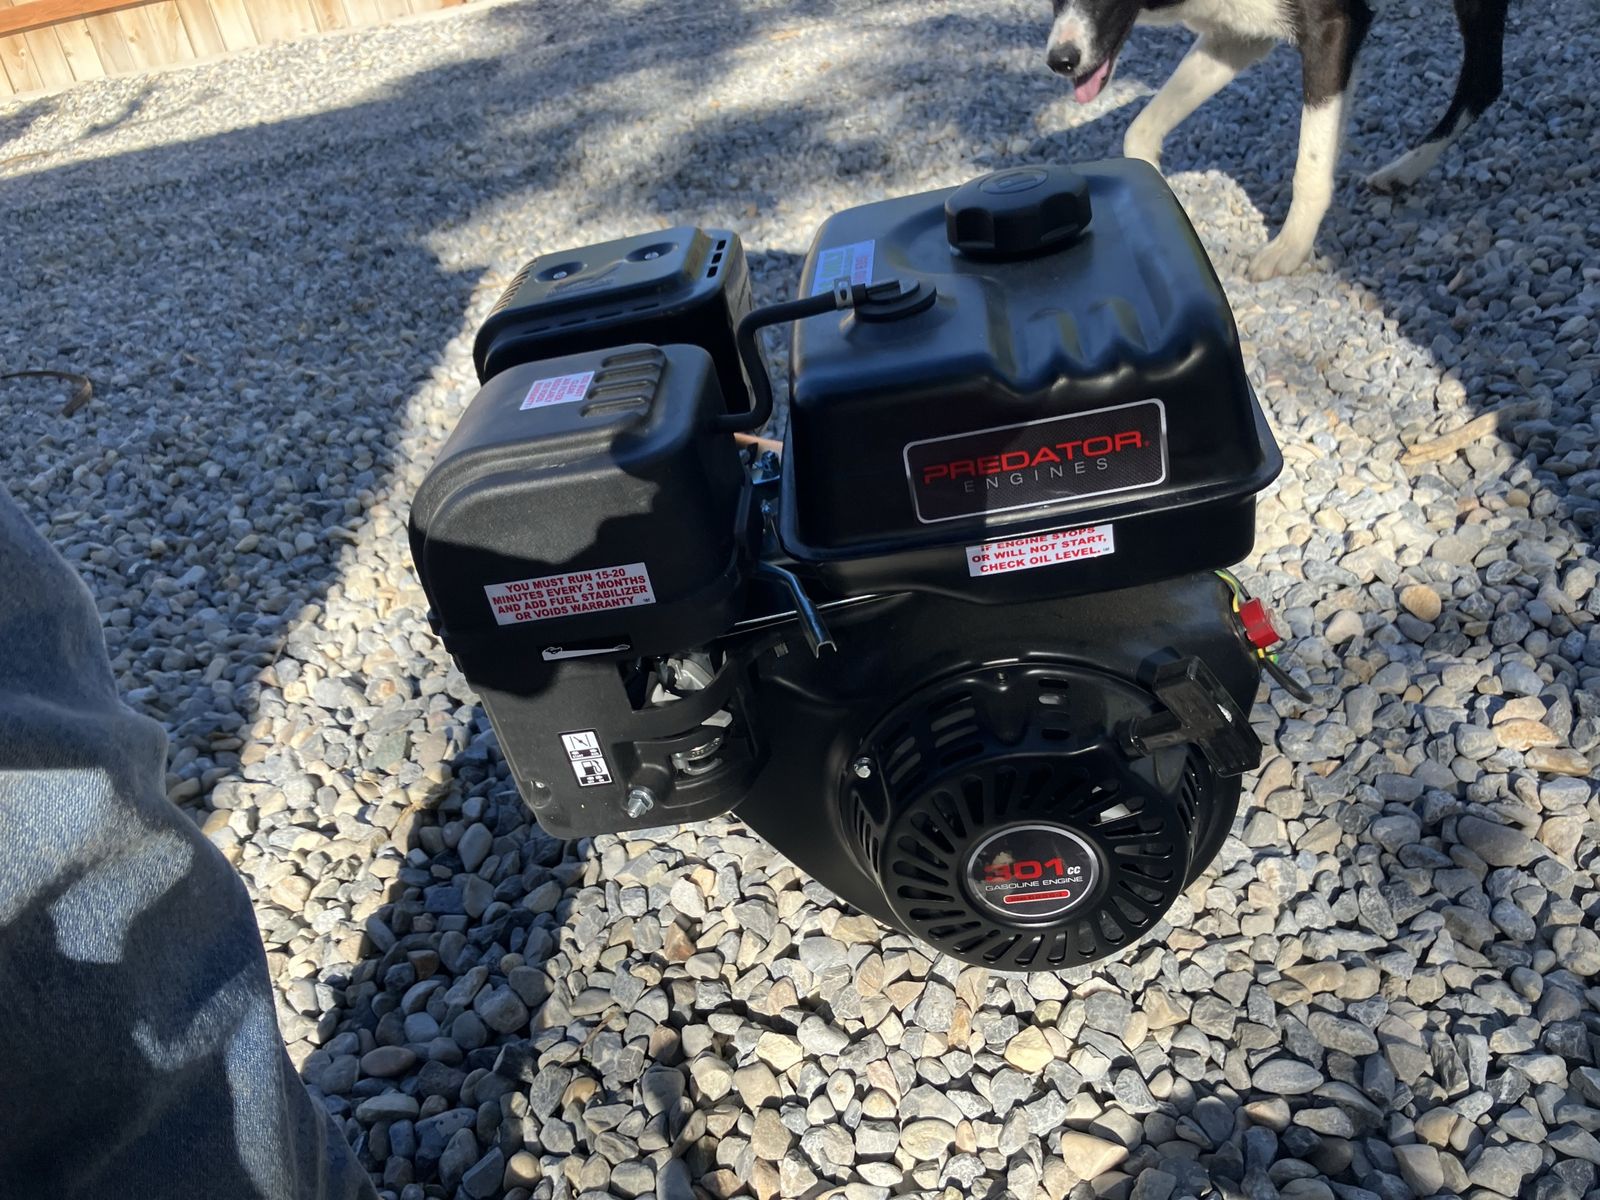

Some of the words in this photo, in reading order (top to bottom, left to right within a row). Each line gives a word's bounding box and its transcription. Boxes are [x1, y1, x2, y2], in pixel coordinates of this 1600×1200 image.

[923, 430, 1142, 484] PREDATOR
[964, 457, 1108, 493] ENGINES
[972, 554, 990, 563] OR
[994, 549, 1025, 559] WILL
[1030, 543, 1057, 554] NOT
[1061, 534, 1107, 548] START,
[997, 535, 1047, 549] ENGINE
[1052, 527, 1095, 540] STOPS
[980, 559, 1025, 572] CHECK
[1029, 555, 1051, 565] OIL
[1055, 547, 1101, 560] LEVEL.
[492, 590, 544, 605] MINUTES
[546, 584, 583, 597] EVERY
[586, 583, 594, 591] 3
[596, 575, 646, 590] MONTHS
[505, 582, 529, 593] YOU
[532, 577, 564, 589] MUST
[567, 573, 592, 584] RUN
[595, 568, 626, 579] 15-20
[498, 603, 521, 614] AND
[524, 599, 547, 610] ADD
[549, 595, 579, 606] FUEL
[581, 585, 648, 601] STABILIZER
[515, 611, 532, 621] OR
[533, 606, 569, 618] VOIDS
[570, 596, 634, 613] WARRANTY
[984, 857, 1064, 881] 301
[985, 880, 1040, 892] GASOLINE
[1042, 876, 1083, 886] ENGINE
